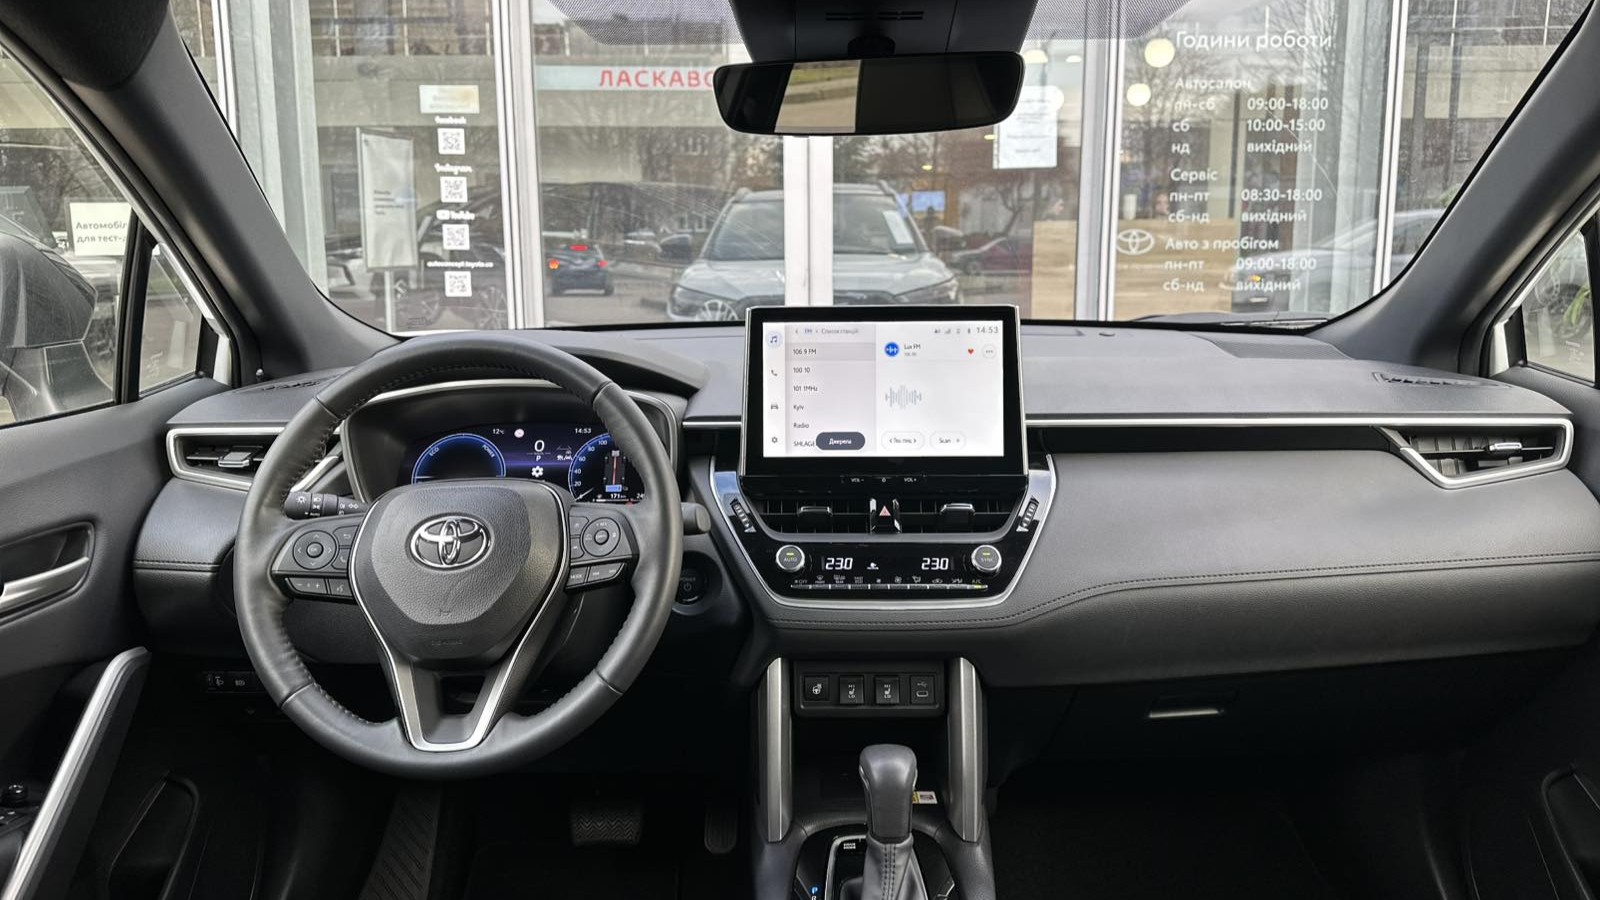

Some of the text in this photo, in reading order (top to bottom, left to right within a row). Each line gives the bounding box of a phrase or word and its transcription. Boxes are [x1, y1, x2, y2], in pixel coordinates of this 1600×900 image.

[1176, 30, 1332, 51] Години роботи
[1175, 78, 1251, 90] Автосалон
[1247, 97, 1329, 111] 09:00-18:00
[1172, 118, 1326, 132] сб 10:00-15:00
[1171, 140, 1313, 155] нд вихідний
[1170, 169, 1218, 183] Сервіс
[1169, 188, 1322, 202] пн-пт 08:30-18:00
[1168, 209, 1307, 224] сб-нд вихідний
[77, 235, 96, 243] для
[1165, 238, 1197, 250] Авто
[1213, 237, 1279, 252] пробігом
[1164, 257, 1317, 271] пн-пт 09:00-18:00
[1162, 278, 1302, 292] сб-нд вихідний
[534, 439, 545, 452] 0
